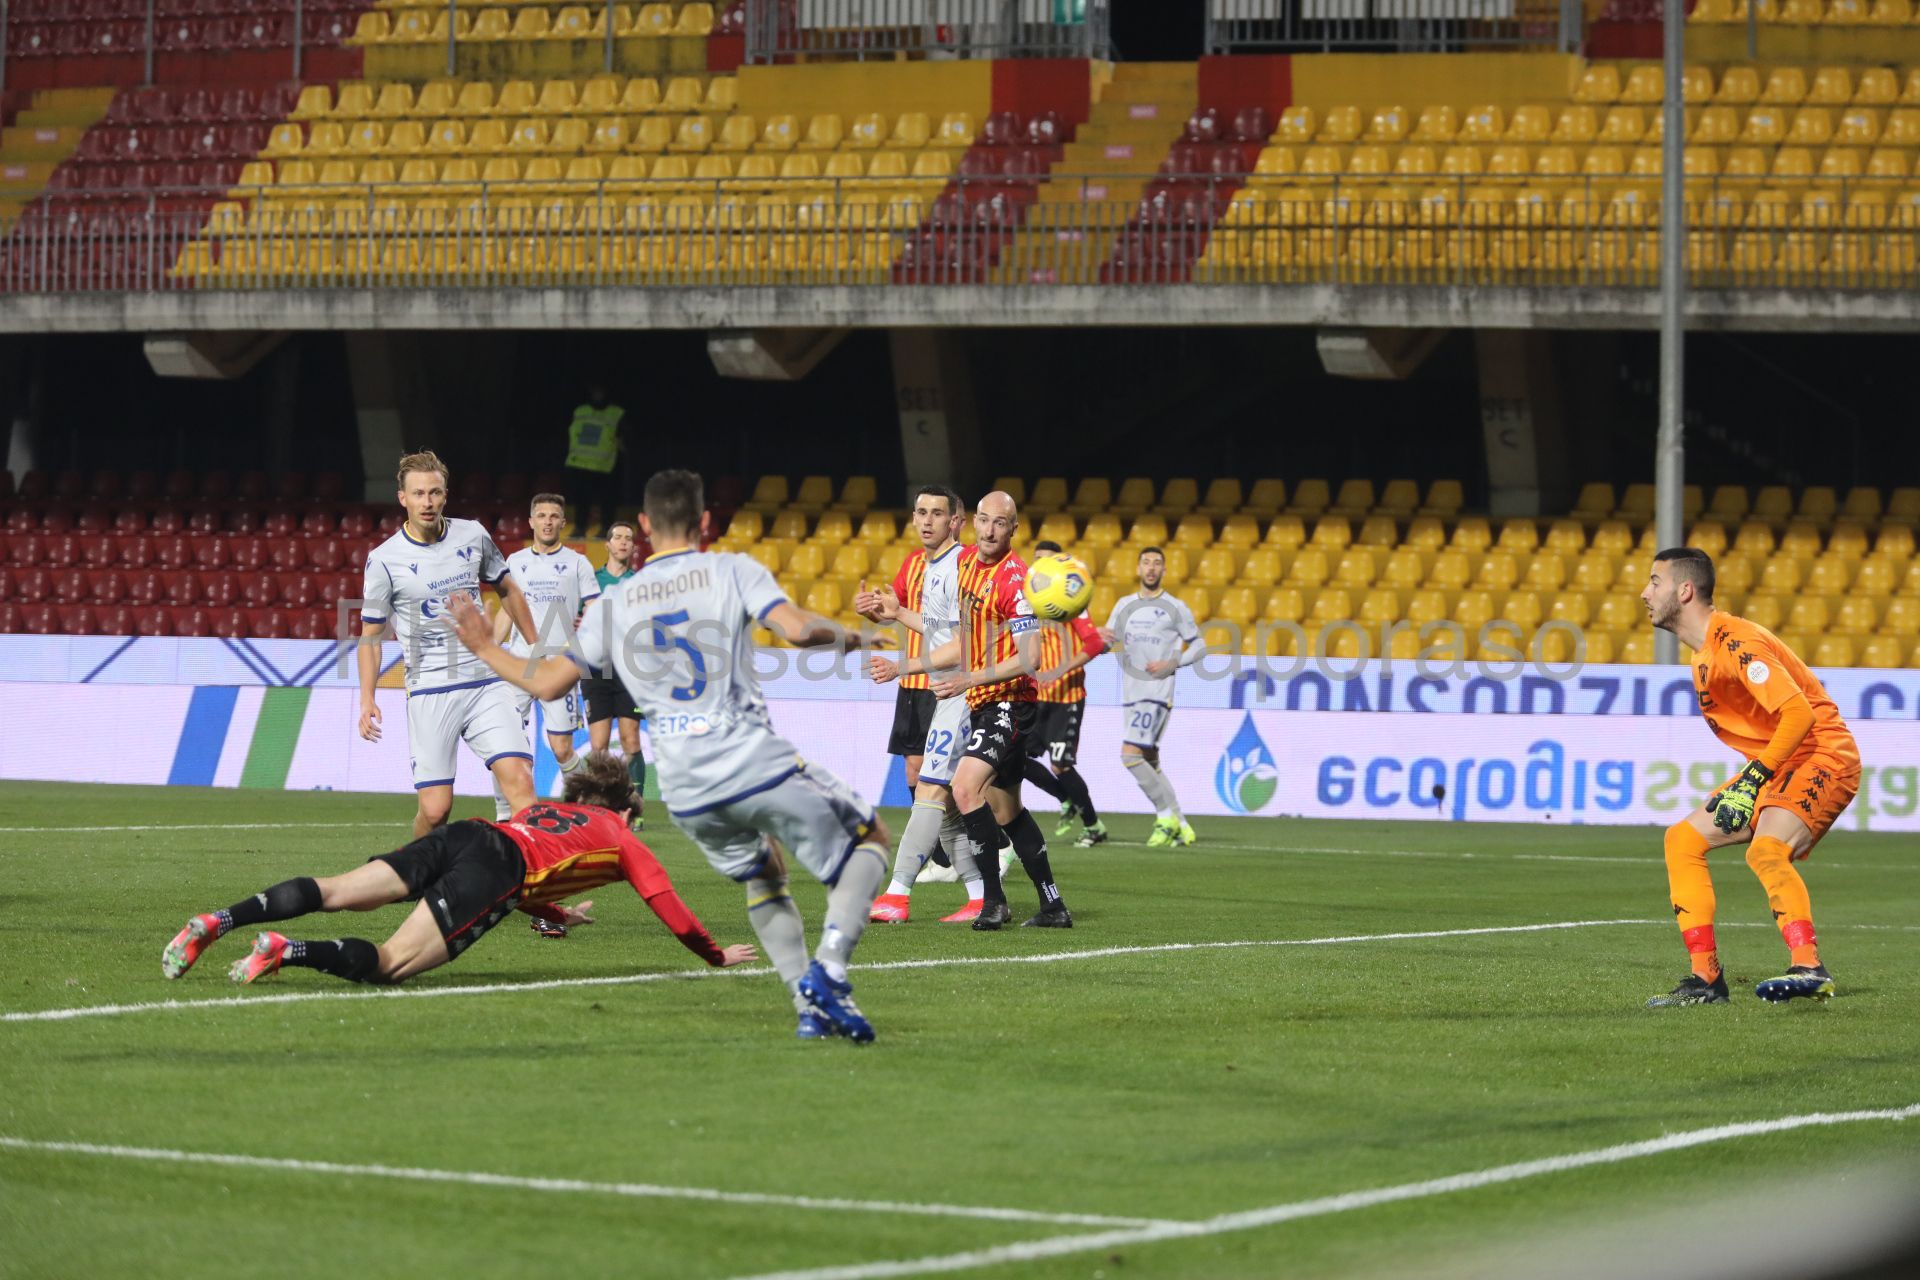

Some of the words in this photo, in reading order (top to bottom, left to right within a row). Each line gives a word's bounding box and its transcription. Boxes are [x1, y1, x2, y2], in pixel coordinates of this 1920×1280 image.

[427, 571, 471, 590] Winelivery
[626, 567, 711, 608] FARAONI
[651, 608, 708, 703] 5
[565, 693, 574, 713] 8
[1131, 710, 1153, 729] 20
[925, 728, 953, 757] 92
[966, 728, 986, 751] 5
